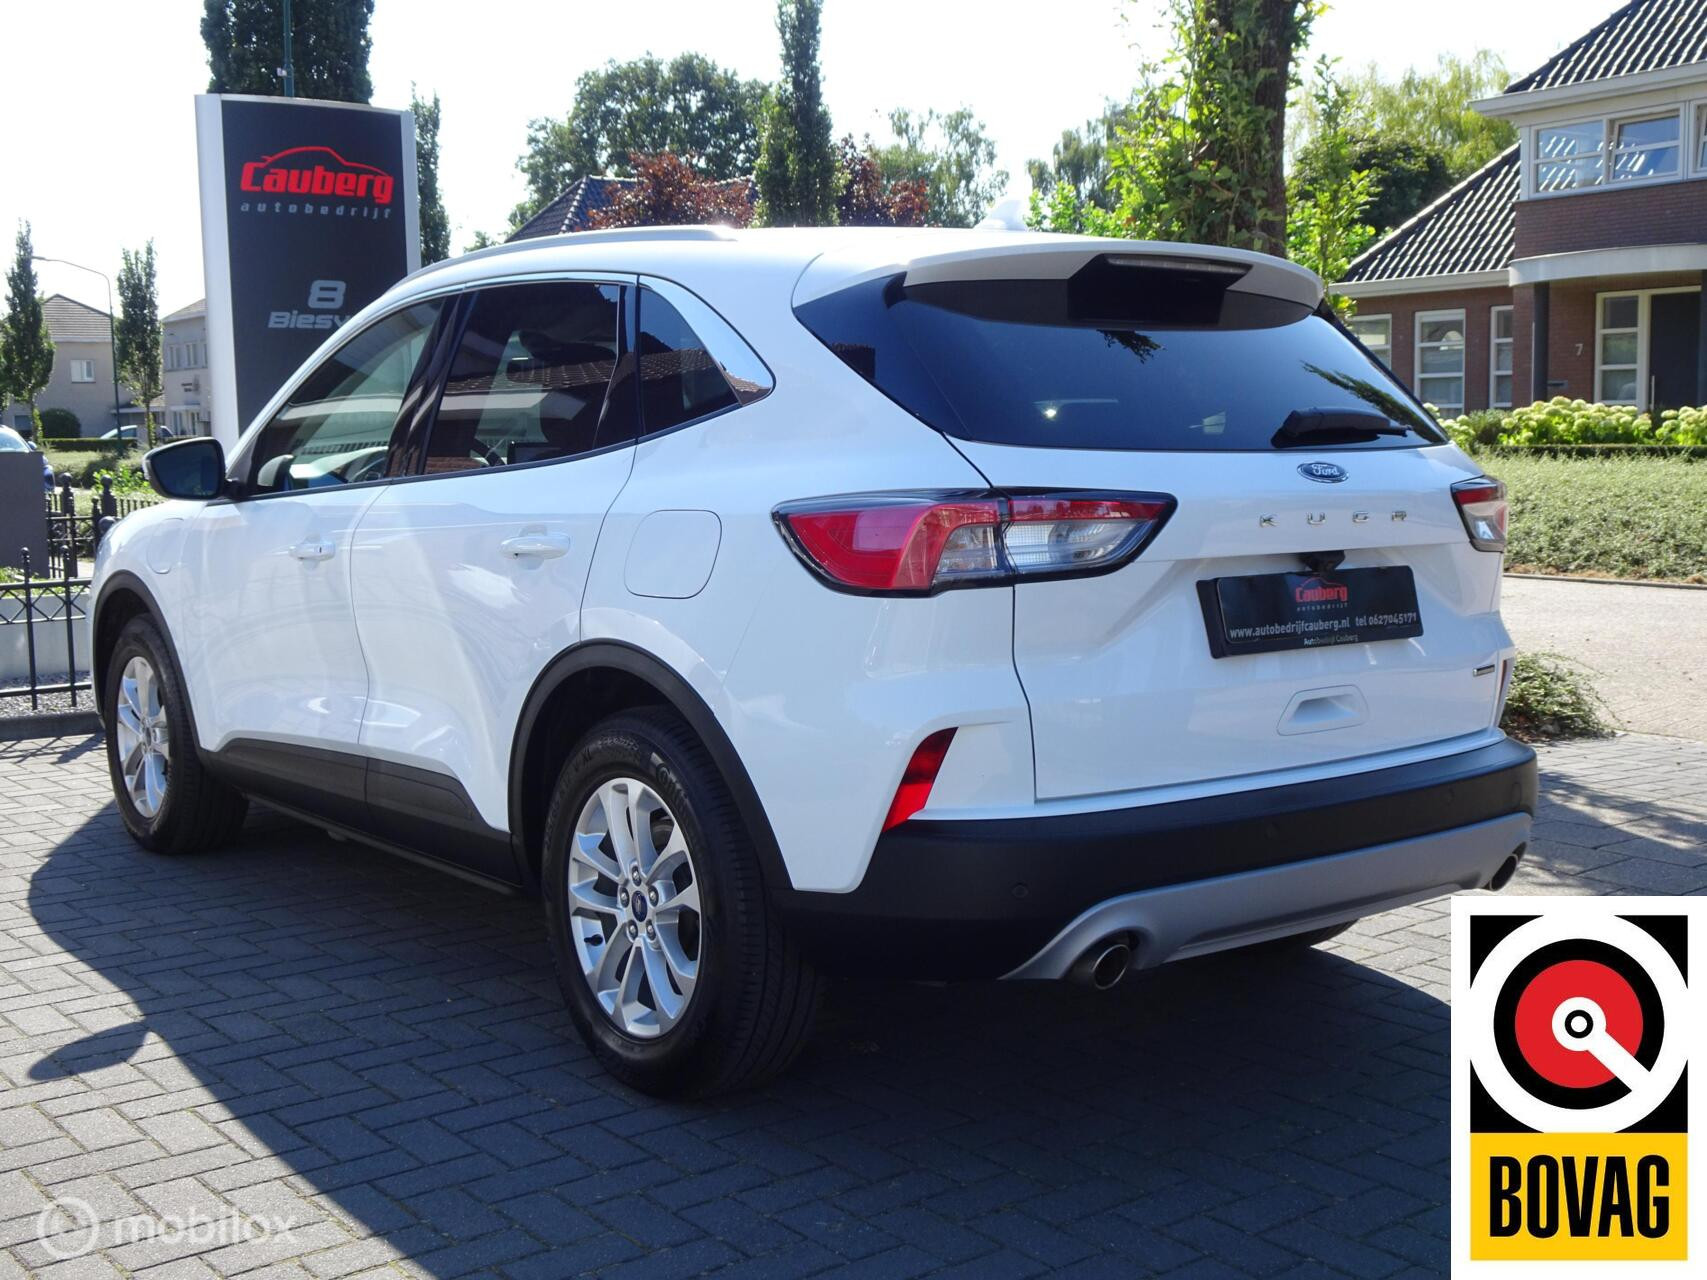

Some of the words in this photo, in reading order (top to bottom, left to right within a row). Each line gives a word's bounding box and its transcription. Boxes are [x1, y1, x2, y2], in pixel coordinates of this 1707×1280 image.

[240, 161, 394, 204] Cauberg
[240, 202, 392, 219] autobedrijf
[307, 279, 346, 309] 8
[1575, 343, 1584, 356] 7
[1296, 585, 1348, 603] Cauberg
[1230, 616, 1350, 639] www.autobedrijfcauberg.nl
[1355, 612, 1367, 626] tel
[1368, 611, 1417, 626] 0627045171
